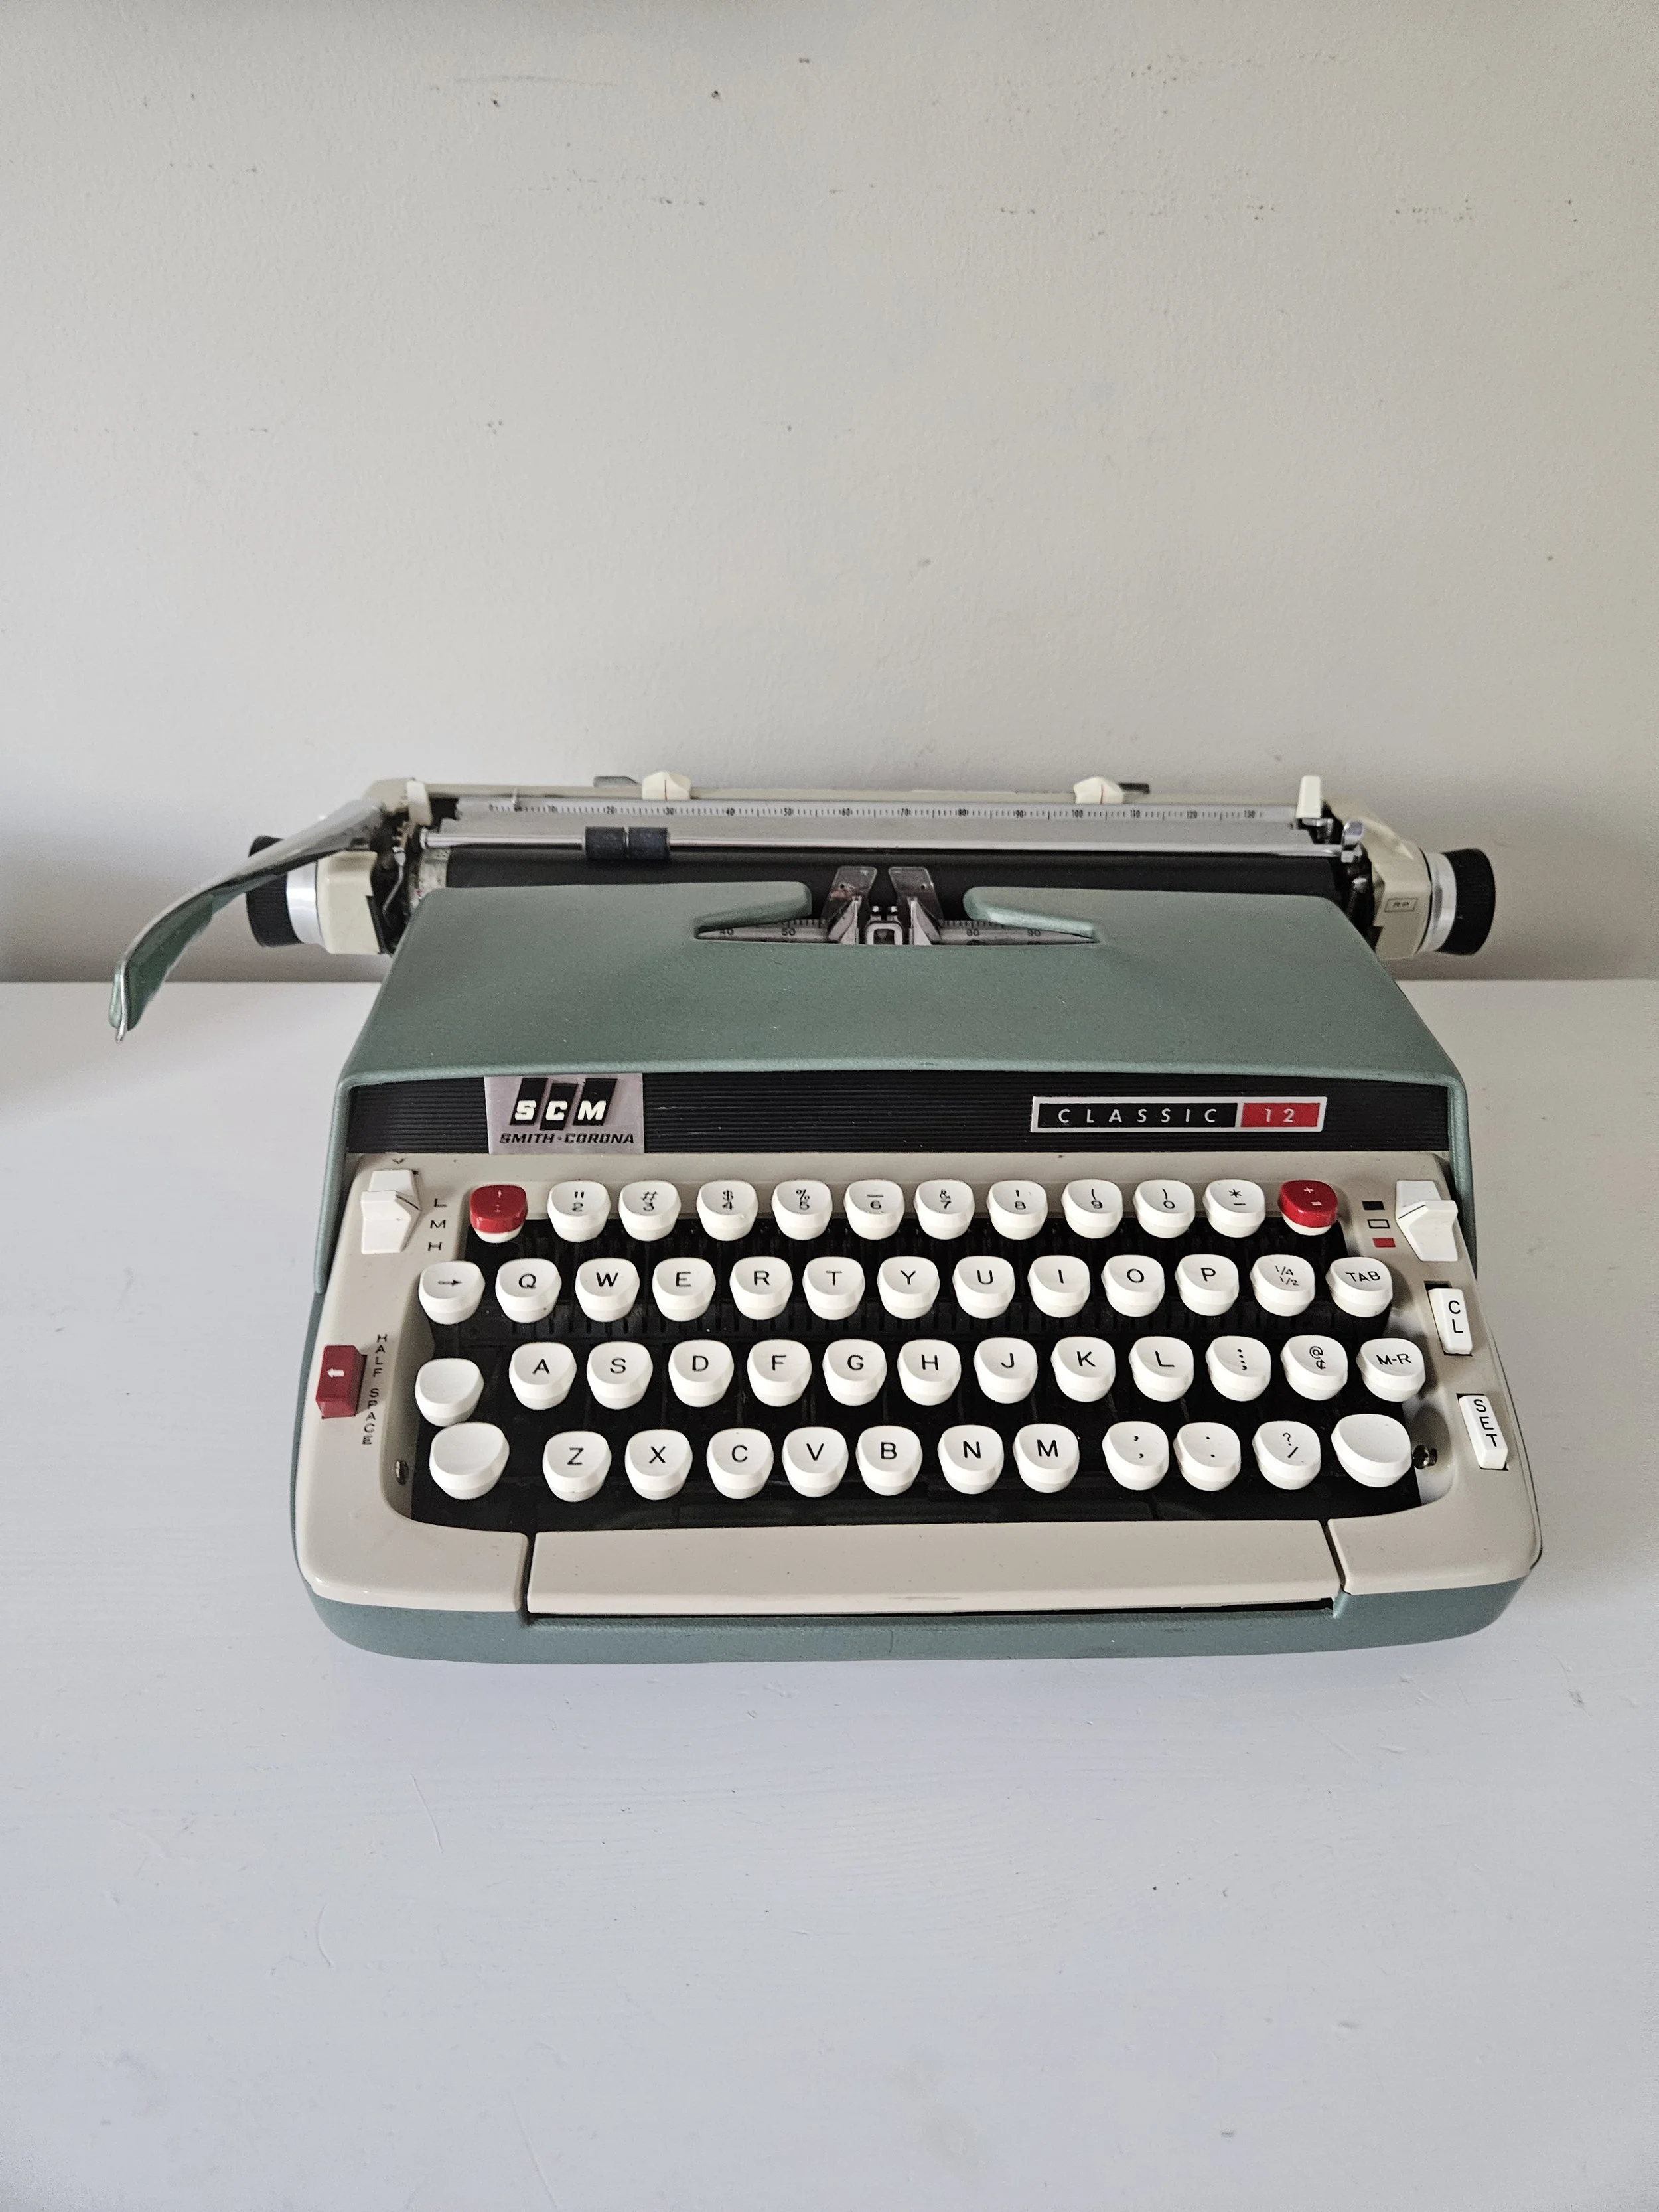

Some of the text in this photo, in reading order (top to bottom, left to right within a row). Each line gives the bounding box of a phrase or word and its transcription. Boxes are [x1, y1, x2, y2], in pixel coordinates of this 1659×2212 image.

[665, 806, 674, 816] 30
[725, 807, 735, 816] 40
[783, 807, 792, 816] 50
[842, 808, 851, 817] 60
[901, 808, 910, 817] 70
[958, 808, 967, 818] 80
[1015, 809, 1025, 818] 90
[1072, 809, 1084, 818] 100
[1130, 809, 1141, 818] 110
[1187, 810, 1198, 819] 120
[514, 1100, 607, 1120] SCM
[1057, 1108, 1295, 1124] CLASSIC 12
[722, 1189, 734, 1201] $
[796, 1189, 810, 1201] %
[939, 1189, 952, 1199] &
[433, 1197, 448, 1209] L
[642, 1201, 655, 1211] 3
[721, 1201, 734, 1211] 4
[799, 1201, 810, 1211] 5
[870, 1200, 882, 1210] 6
[940, 1200, 952, 1210] 7
[1014, 1201, 1027, 1210] 8
[1090, 1200, 1103, 1209] 9
[430, 1219, 446, 1229] M
[427, 1242, 443, 1252] H
[518, 1273, 537, 1289] Q
[596, 1272, 619, 1288] W
[675, 1271, 691, 1287] E
[753, 1270, 770, 1286] R
[826, 1270, 842, 1286] T
[900, 1270, 916, 1285] Y
[977, 1270, 993, 1285] U
[1058, 1269, 1064, 1284] I
[1126, 1268, 1145, 1284] O
[1200, 1267, 1216, 1282] P
[1346, 1270, 1381, 1282] TAB
[1076, 1351, 1096, 1367] K
[1155, 1351, 1175, 1368] L
[1309, 1345, 1323, 1359] @
[1376, 1353, 1412, 1366] M-R
[532, 1358, 550, 1375] A
[610, 1358, 627, 1374] S
[691, 1355, 709, 1372] D
[772, 1355, 786, 1372] F
[847, 1354, 864, 1371] G
[921, 1354, 939, 1371] H
[1001, 1353, 1015, 1369] J
[1315, 1359, 1327, 1370] ¢
[362, 1333, 388, 1445] HALF SPACE
[1473, 1398, 1498, 1448] SET
[1282, 1432, 1292, 1447] ?
[648, 1446, 666, 1464] X
[731, 1445, 748, 1463] C
[806, 1443, 824, 1461] V
[881, 1441, 897, 1460] B
[963, 1441, 981, 1459] N
[1037, 1439, 1058, 1457] M
[1287, 1446, 1299, 1459] /
[567, 1447, 584, 1466] Z
